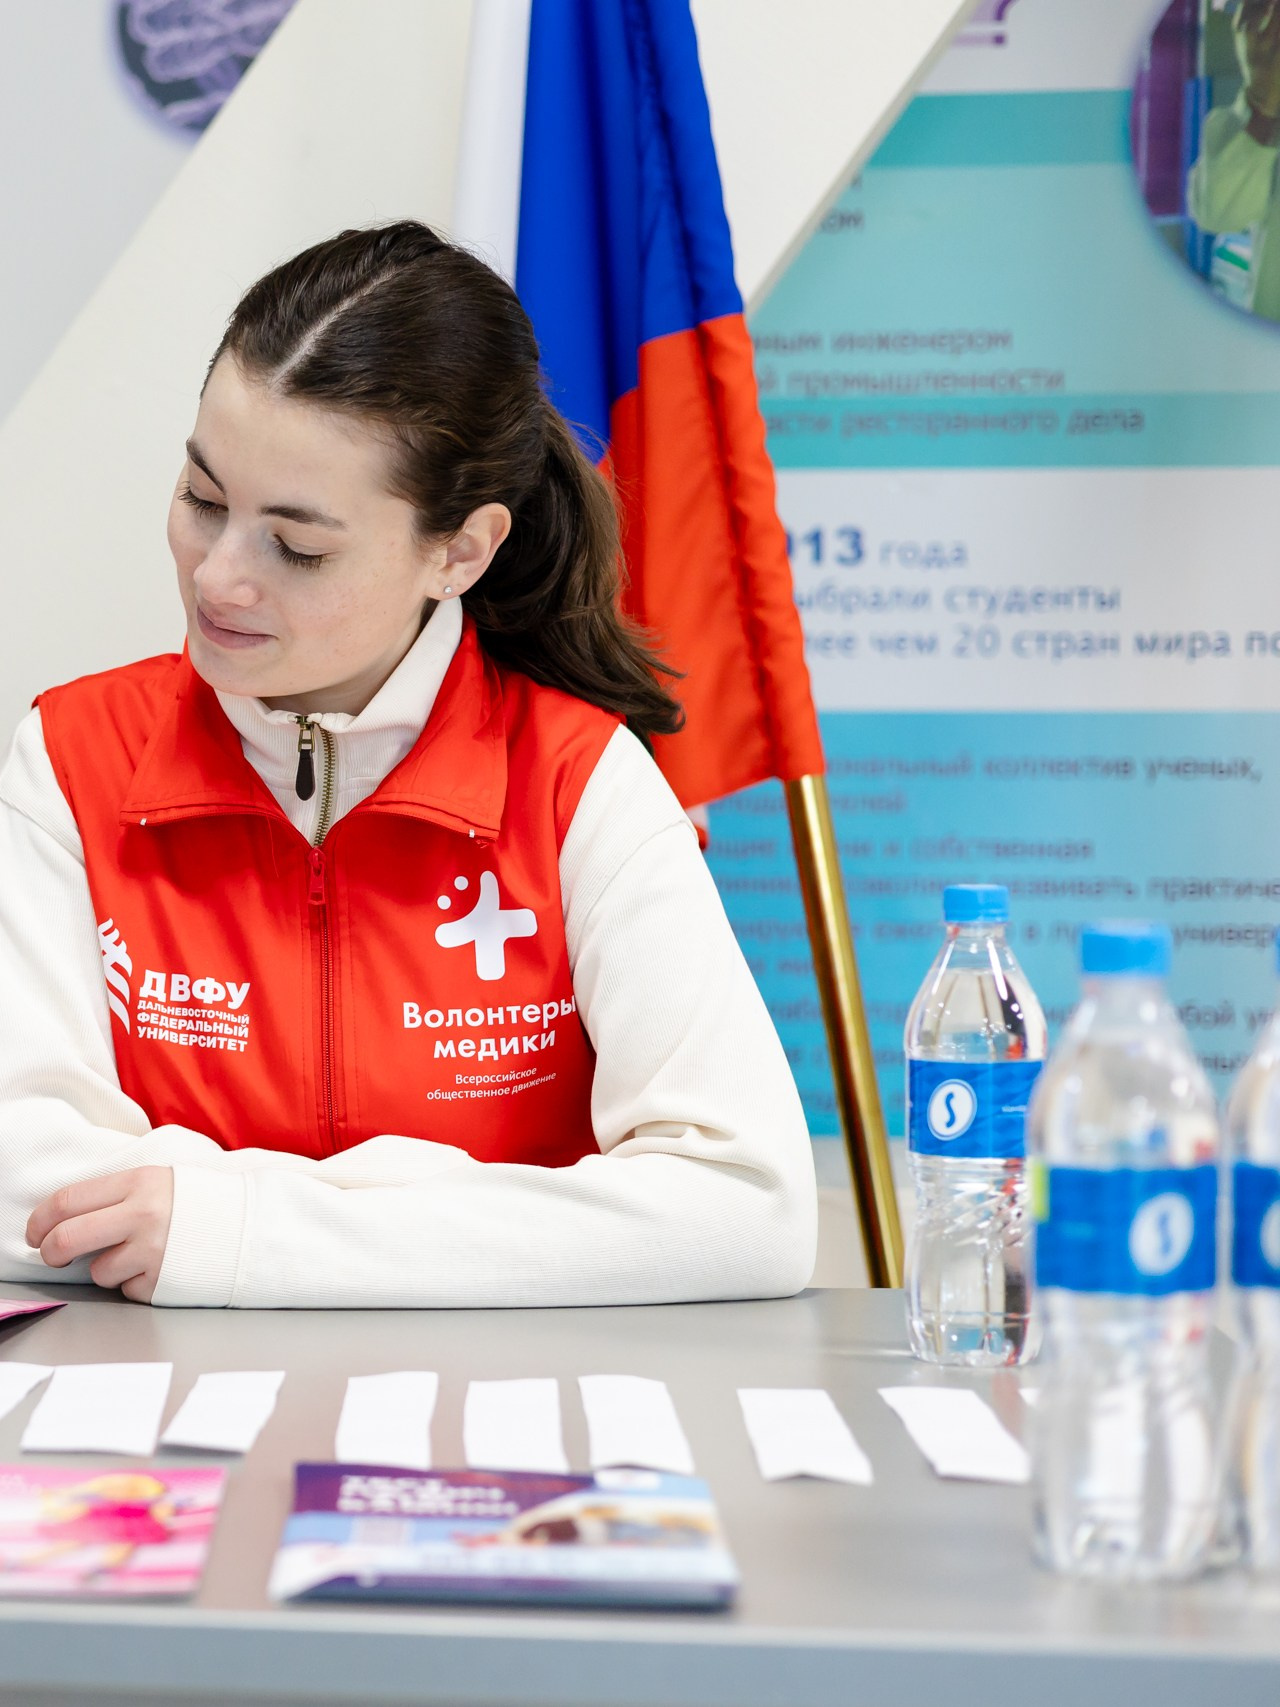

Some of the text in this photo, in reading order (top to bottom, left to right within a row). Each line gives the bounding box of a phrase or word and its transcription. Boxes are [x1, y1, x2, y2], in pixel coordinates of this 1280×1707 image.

[840, 410, 1060, 440] ресторанного
[1065, 408, 1145, 436] дела
[786, 525, 968, 570] 13 года
[794, 578, 1121, 619] ыбрали студенты
[871, 631, 939, 658] чем
[952, 622, 1001, 660] 20
[1011, 631, 1121, 664] стран
[1132, 631, 1232, 664] мира
[139, 969, 251, 1010] ДВФУ
[137, 1000, 250, 1025] ДАЛЬНЕВОСТОЧНЫЙ
[137, 1012, 249, 1038] ФЕДЕРАЛЬНЫЙ
[403, 994, 577, 1028] Волонтеры
[137, 1025, 248, 1052] УНИВЕРСИТЕТ
[433, 1030, 556, 1062] медики
[426, 1072, 557, 1101] общественное движение
[455, 1067, 538, 1086] Всероссийское
